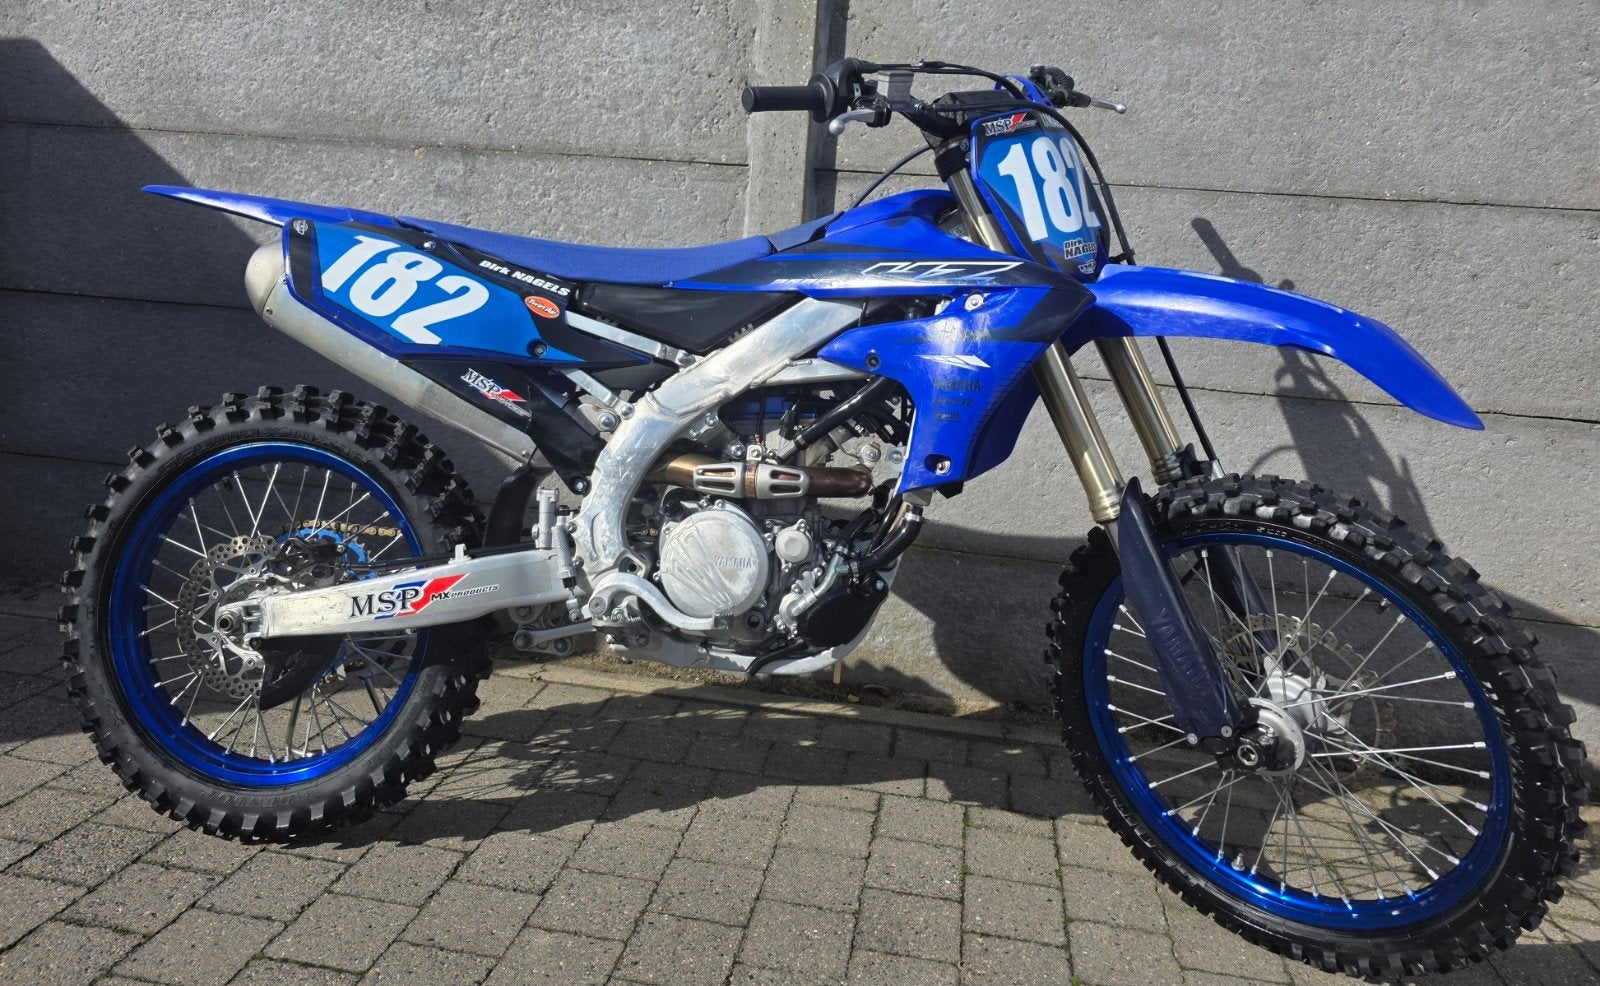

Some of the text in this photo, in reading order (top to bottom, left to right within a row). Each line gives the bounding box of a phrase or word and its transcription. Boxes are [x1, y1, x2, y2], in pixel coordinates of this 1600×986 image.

[983, 118, 1011, 136] MSP
[998, 137, 1101, 242] 182
[1064, 238, 1083, 249] Dirk
[321, 235, 490, 345] 182
[479, 259, 571, 297] Dirk NAGELS
[460, 368, 500, 396] MSP
[934, 378, 982, 391] YAMAHA
[716, 556, 755, 569] YAMAHA
[350, 587, 420, 618] MSP
